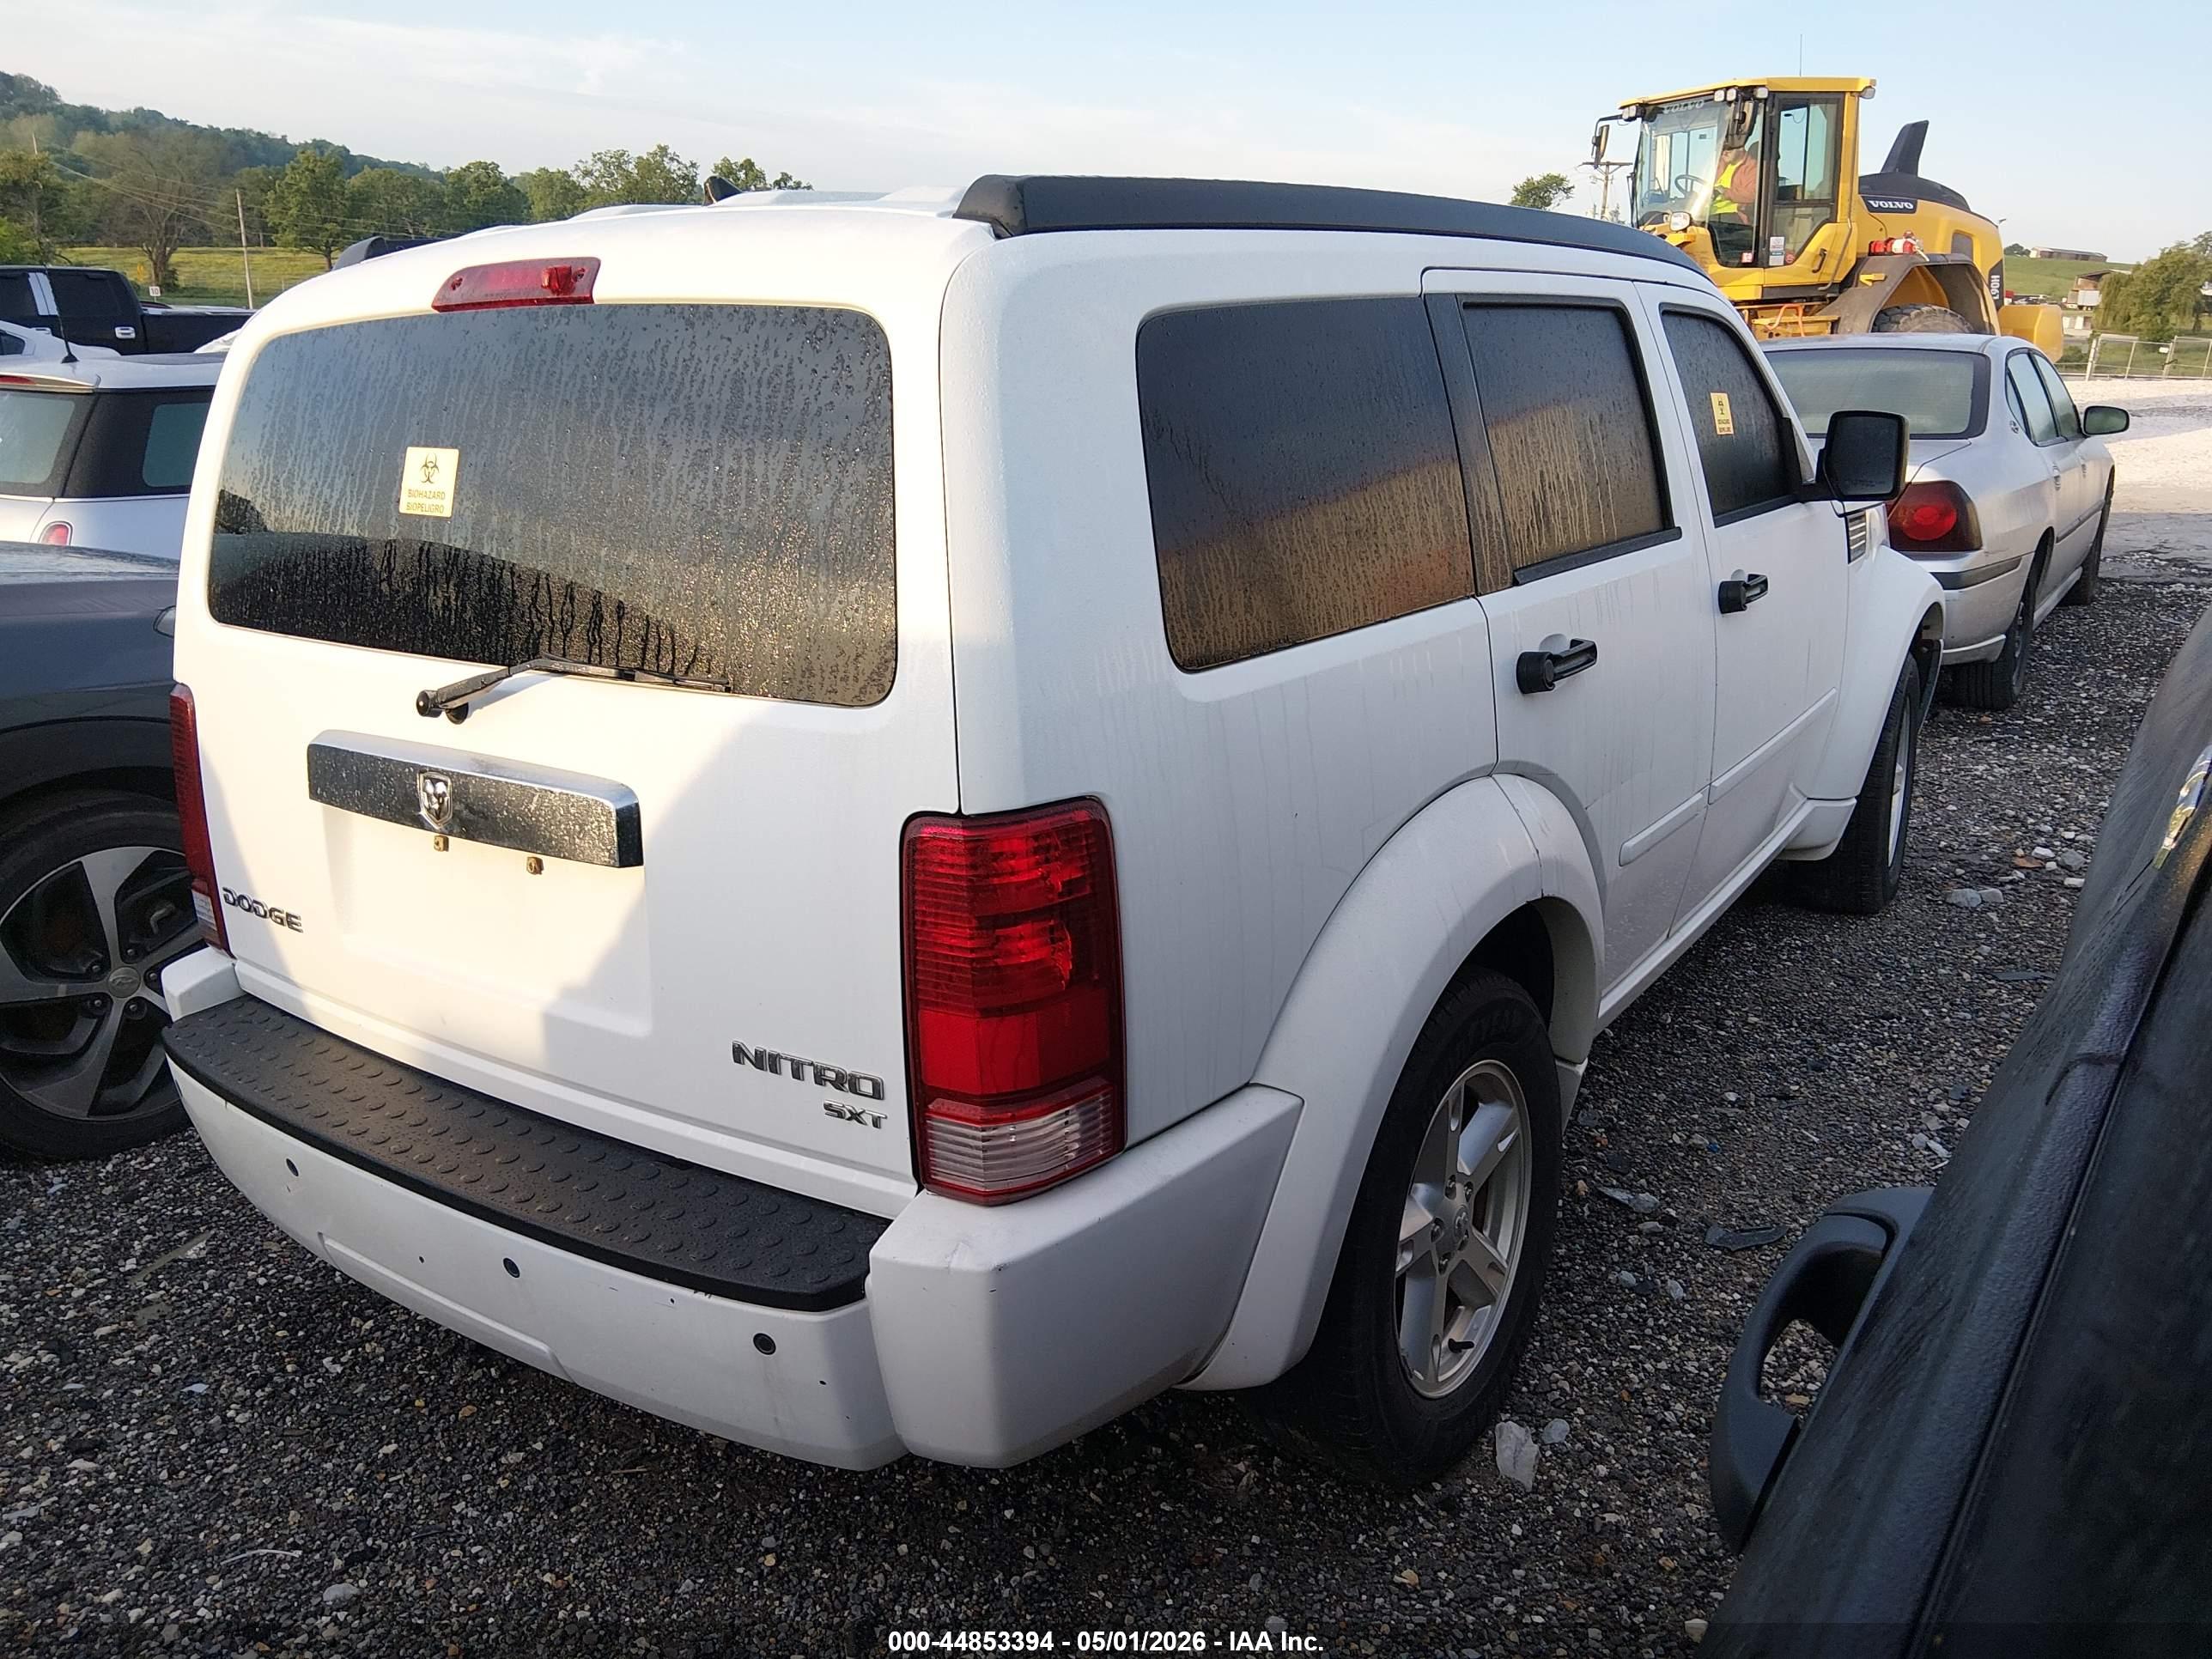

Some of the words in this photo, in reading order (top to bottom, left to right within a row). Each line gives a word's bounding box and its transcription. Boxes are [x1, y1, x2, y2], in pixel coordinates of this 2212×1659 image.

[1662, 100, 1704, 114] VOLVO
[1868, 200, 1914, 210] VOLVO
[1990, 275, 2001, 300] L90H
[408, 489, 446, 500] BIOHAZARD
[406, 502, 445, 514] BIOPELIGRO
[222, 887, 304, 933] DODGE
[732, 1040, 884, 1100] NITRO
[823, 1099, 888, 1129] SXT
